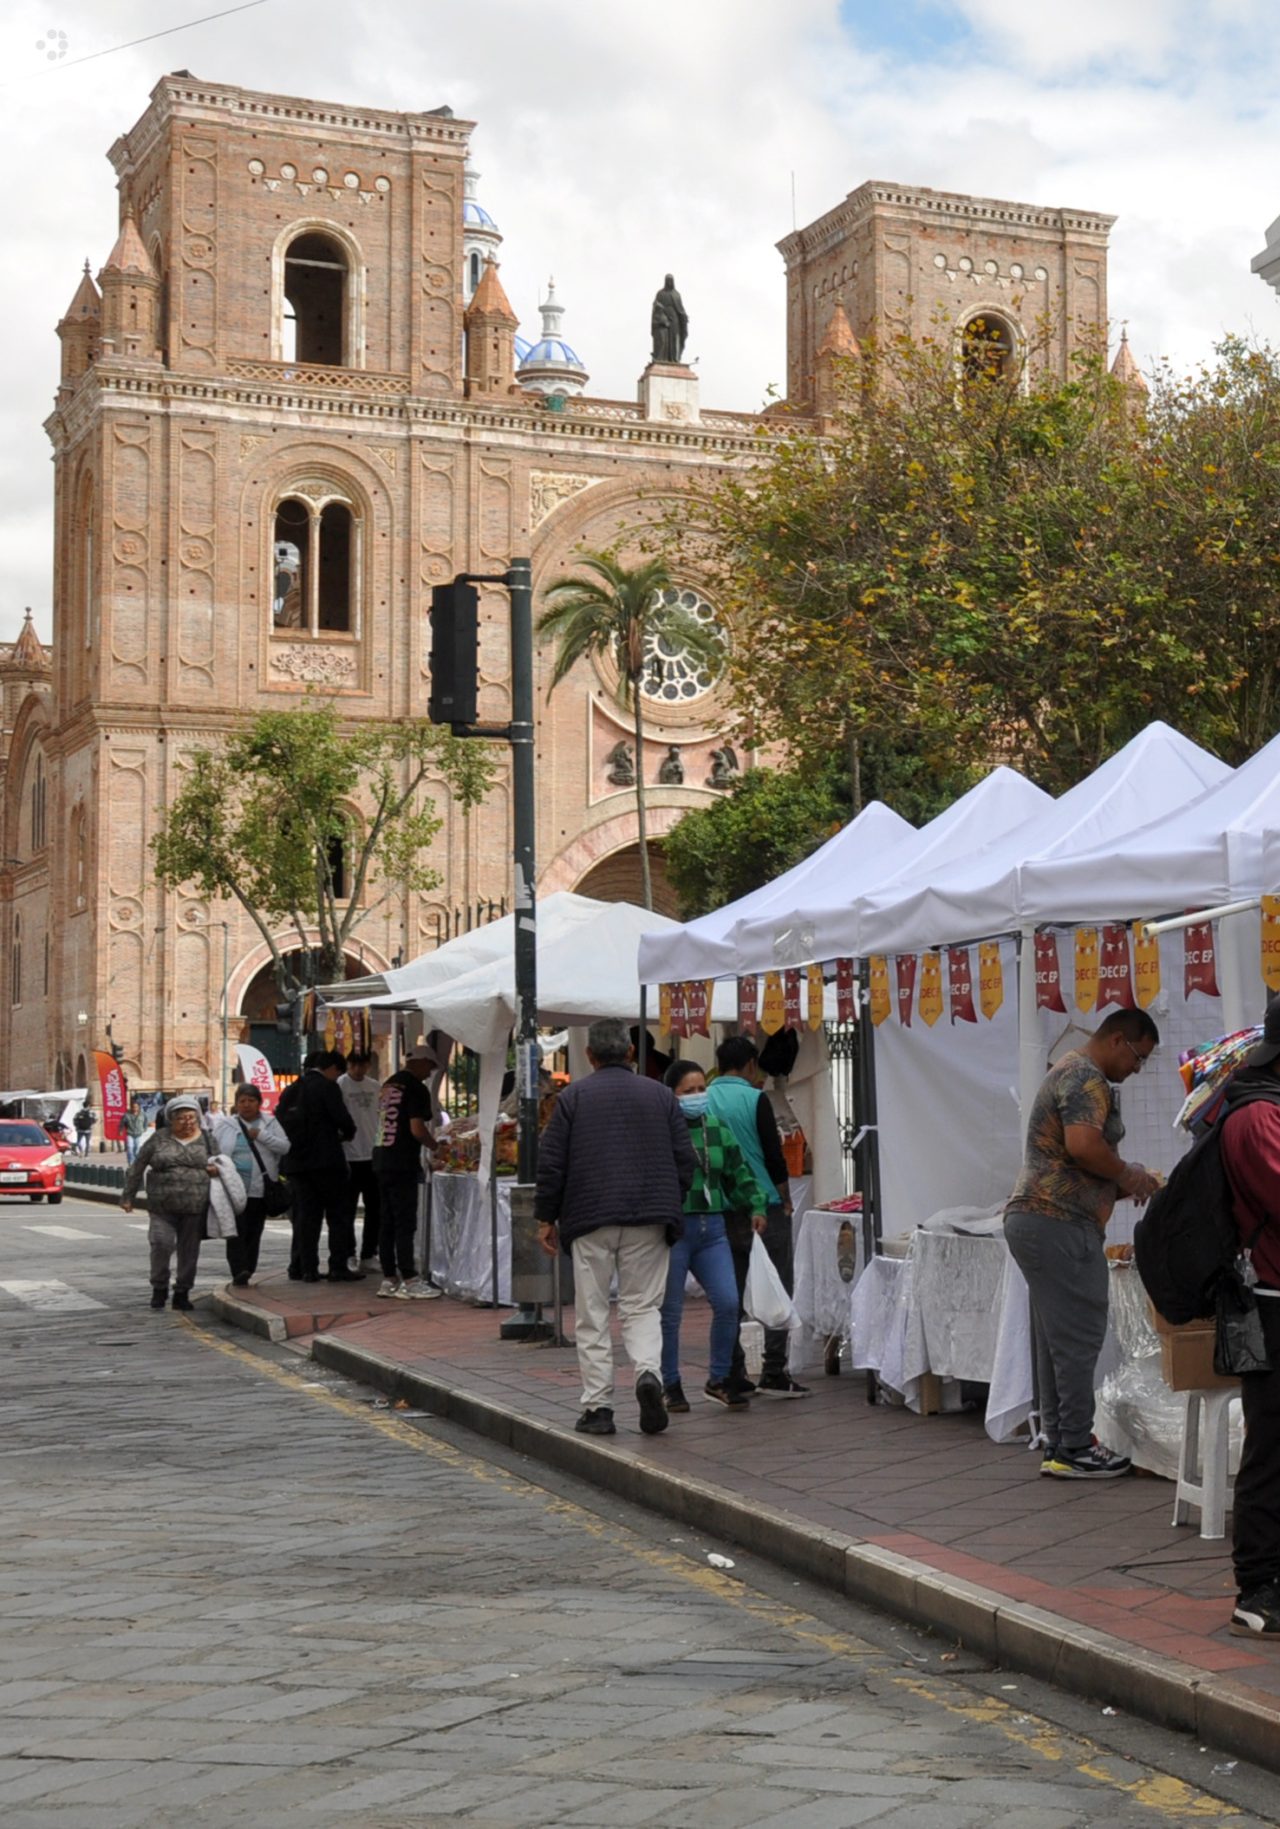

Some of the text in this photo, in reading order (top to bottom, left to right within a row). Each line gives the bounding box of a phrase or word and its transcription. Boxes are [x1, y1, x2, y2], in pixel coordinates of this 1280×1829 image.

[1184, 949, 1213, 965] DEC EP
[1048, 970, 1058, 983] EP
[1076, 968, 1090, 981] DEC
[1119, 965, 1128, 978] EP
[256, 1058, 271, 1091] ENCA
